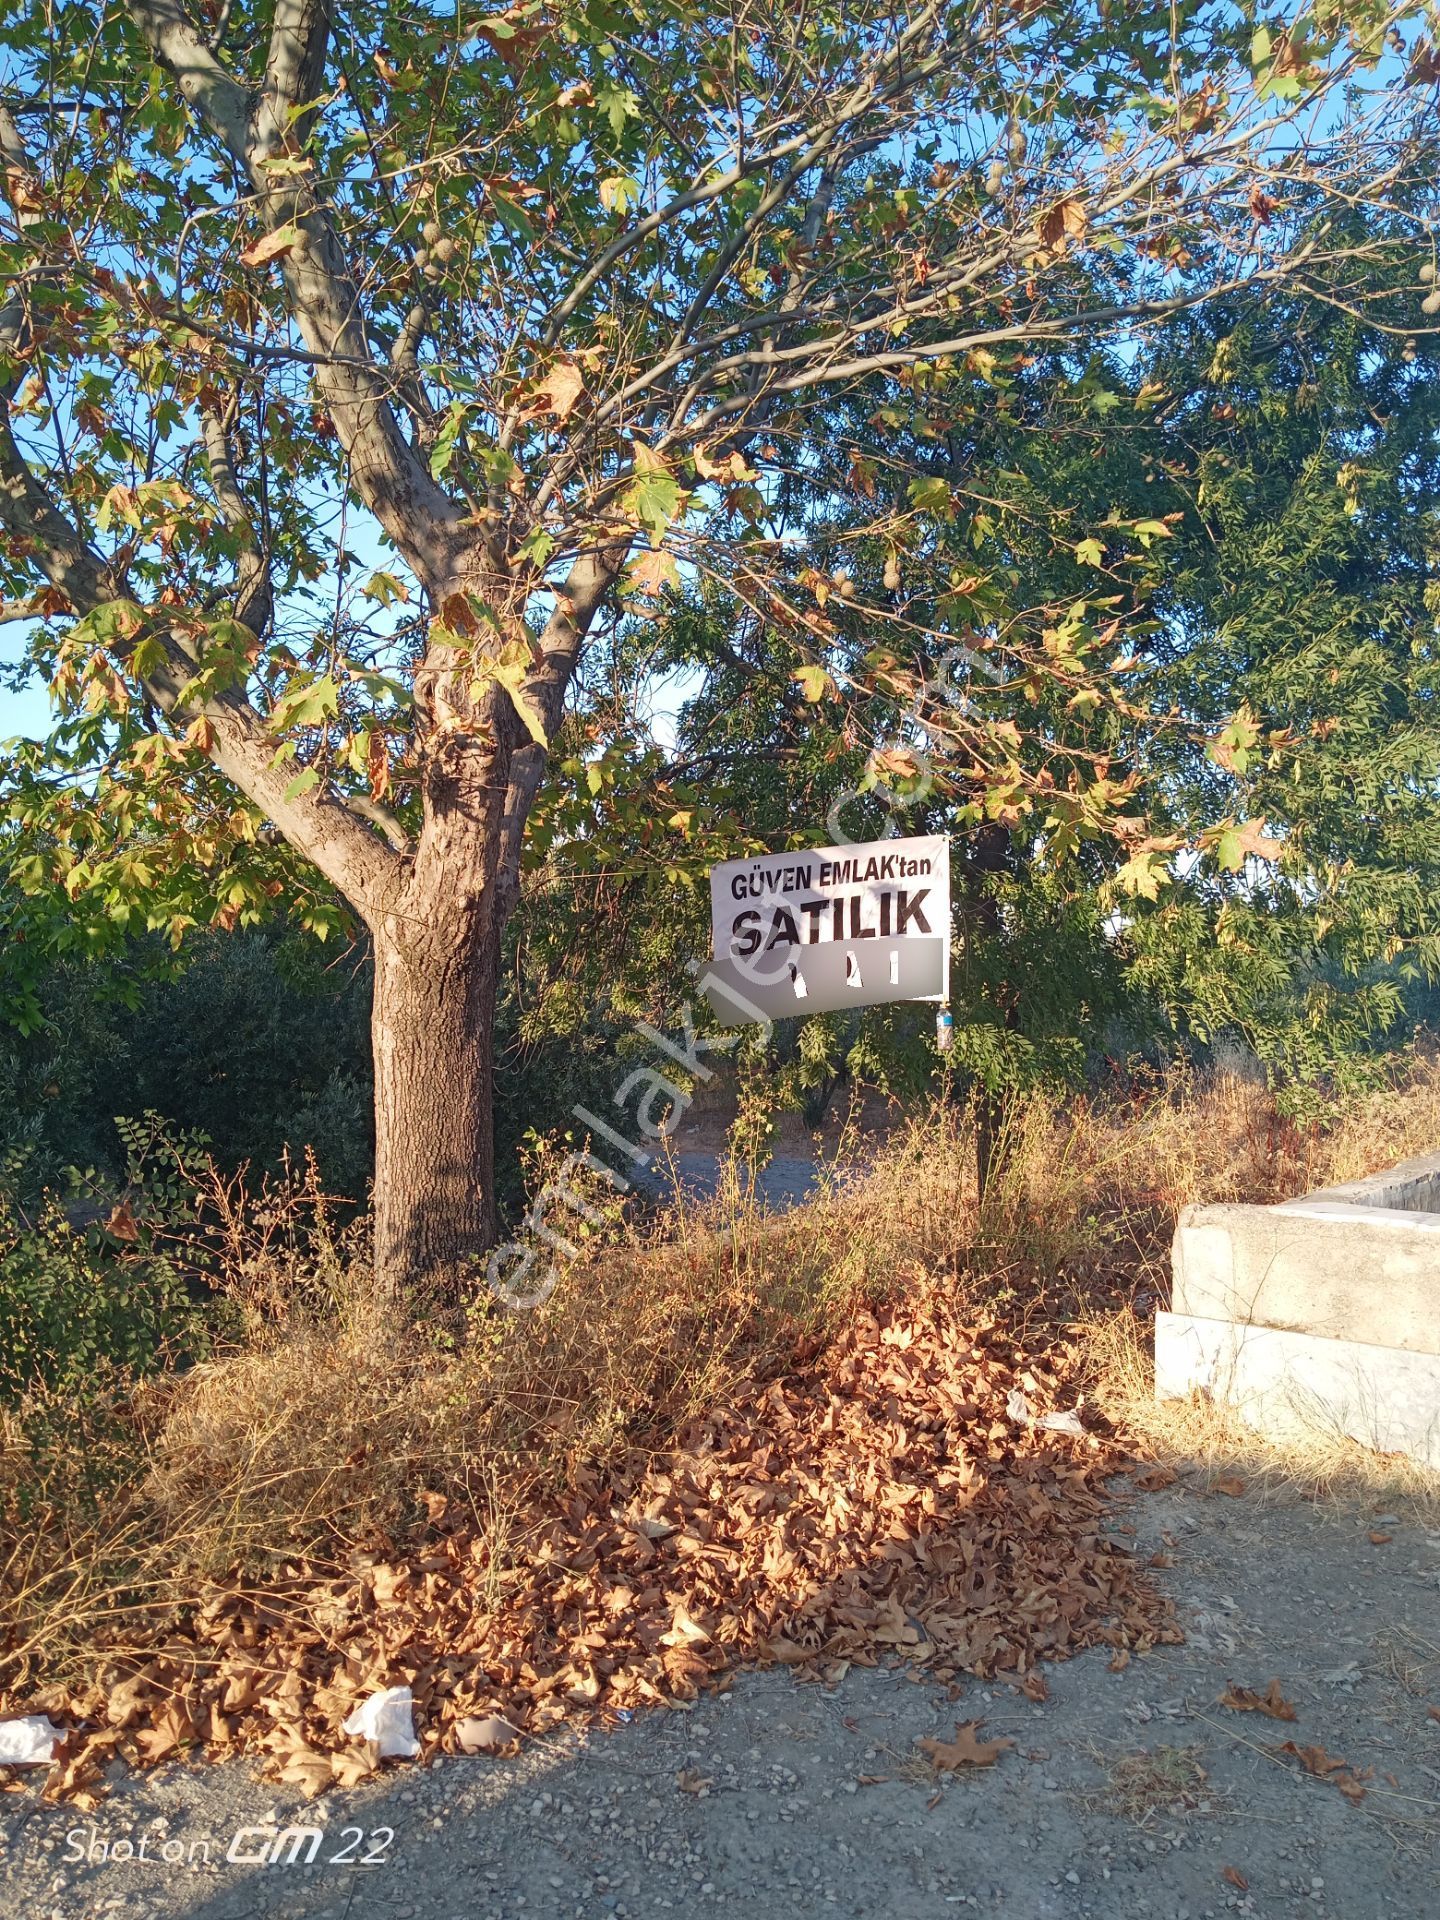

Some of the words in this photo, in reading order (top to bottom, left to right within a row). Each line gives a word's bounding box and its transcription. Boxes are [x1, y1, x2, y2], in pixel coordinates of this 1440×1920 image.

[731, 864, 812, 900] GÜVEN
[819, 854, 932, 888] EMLAK'tan
[731, 888, 933, 956] SATILIK
